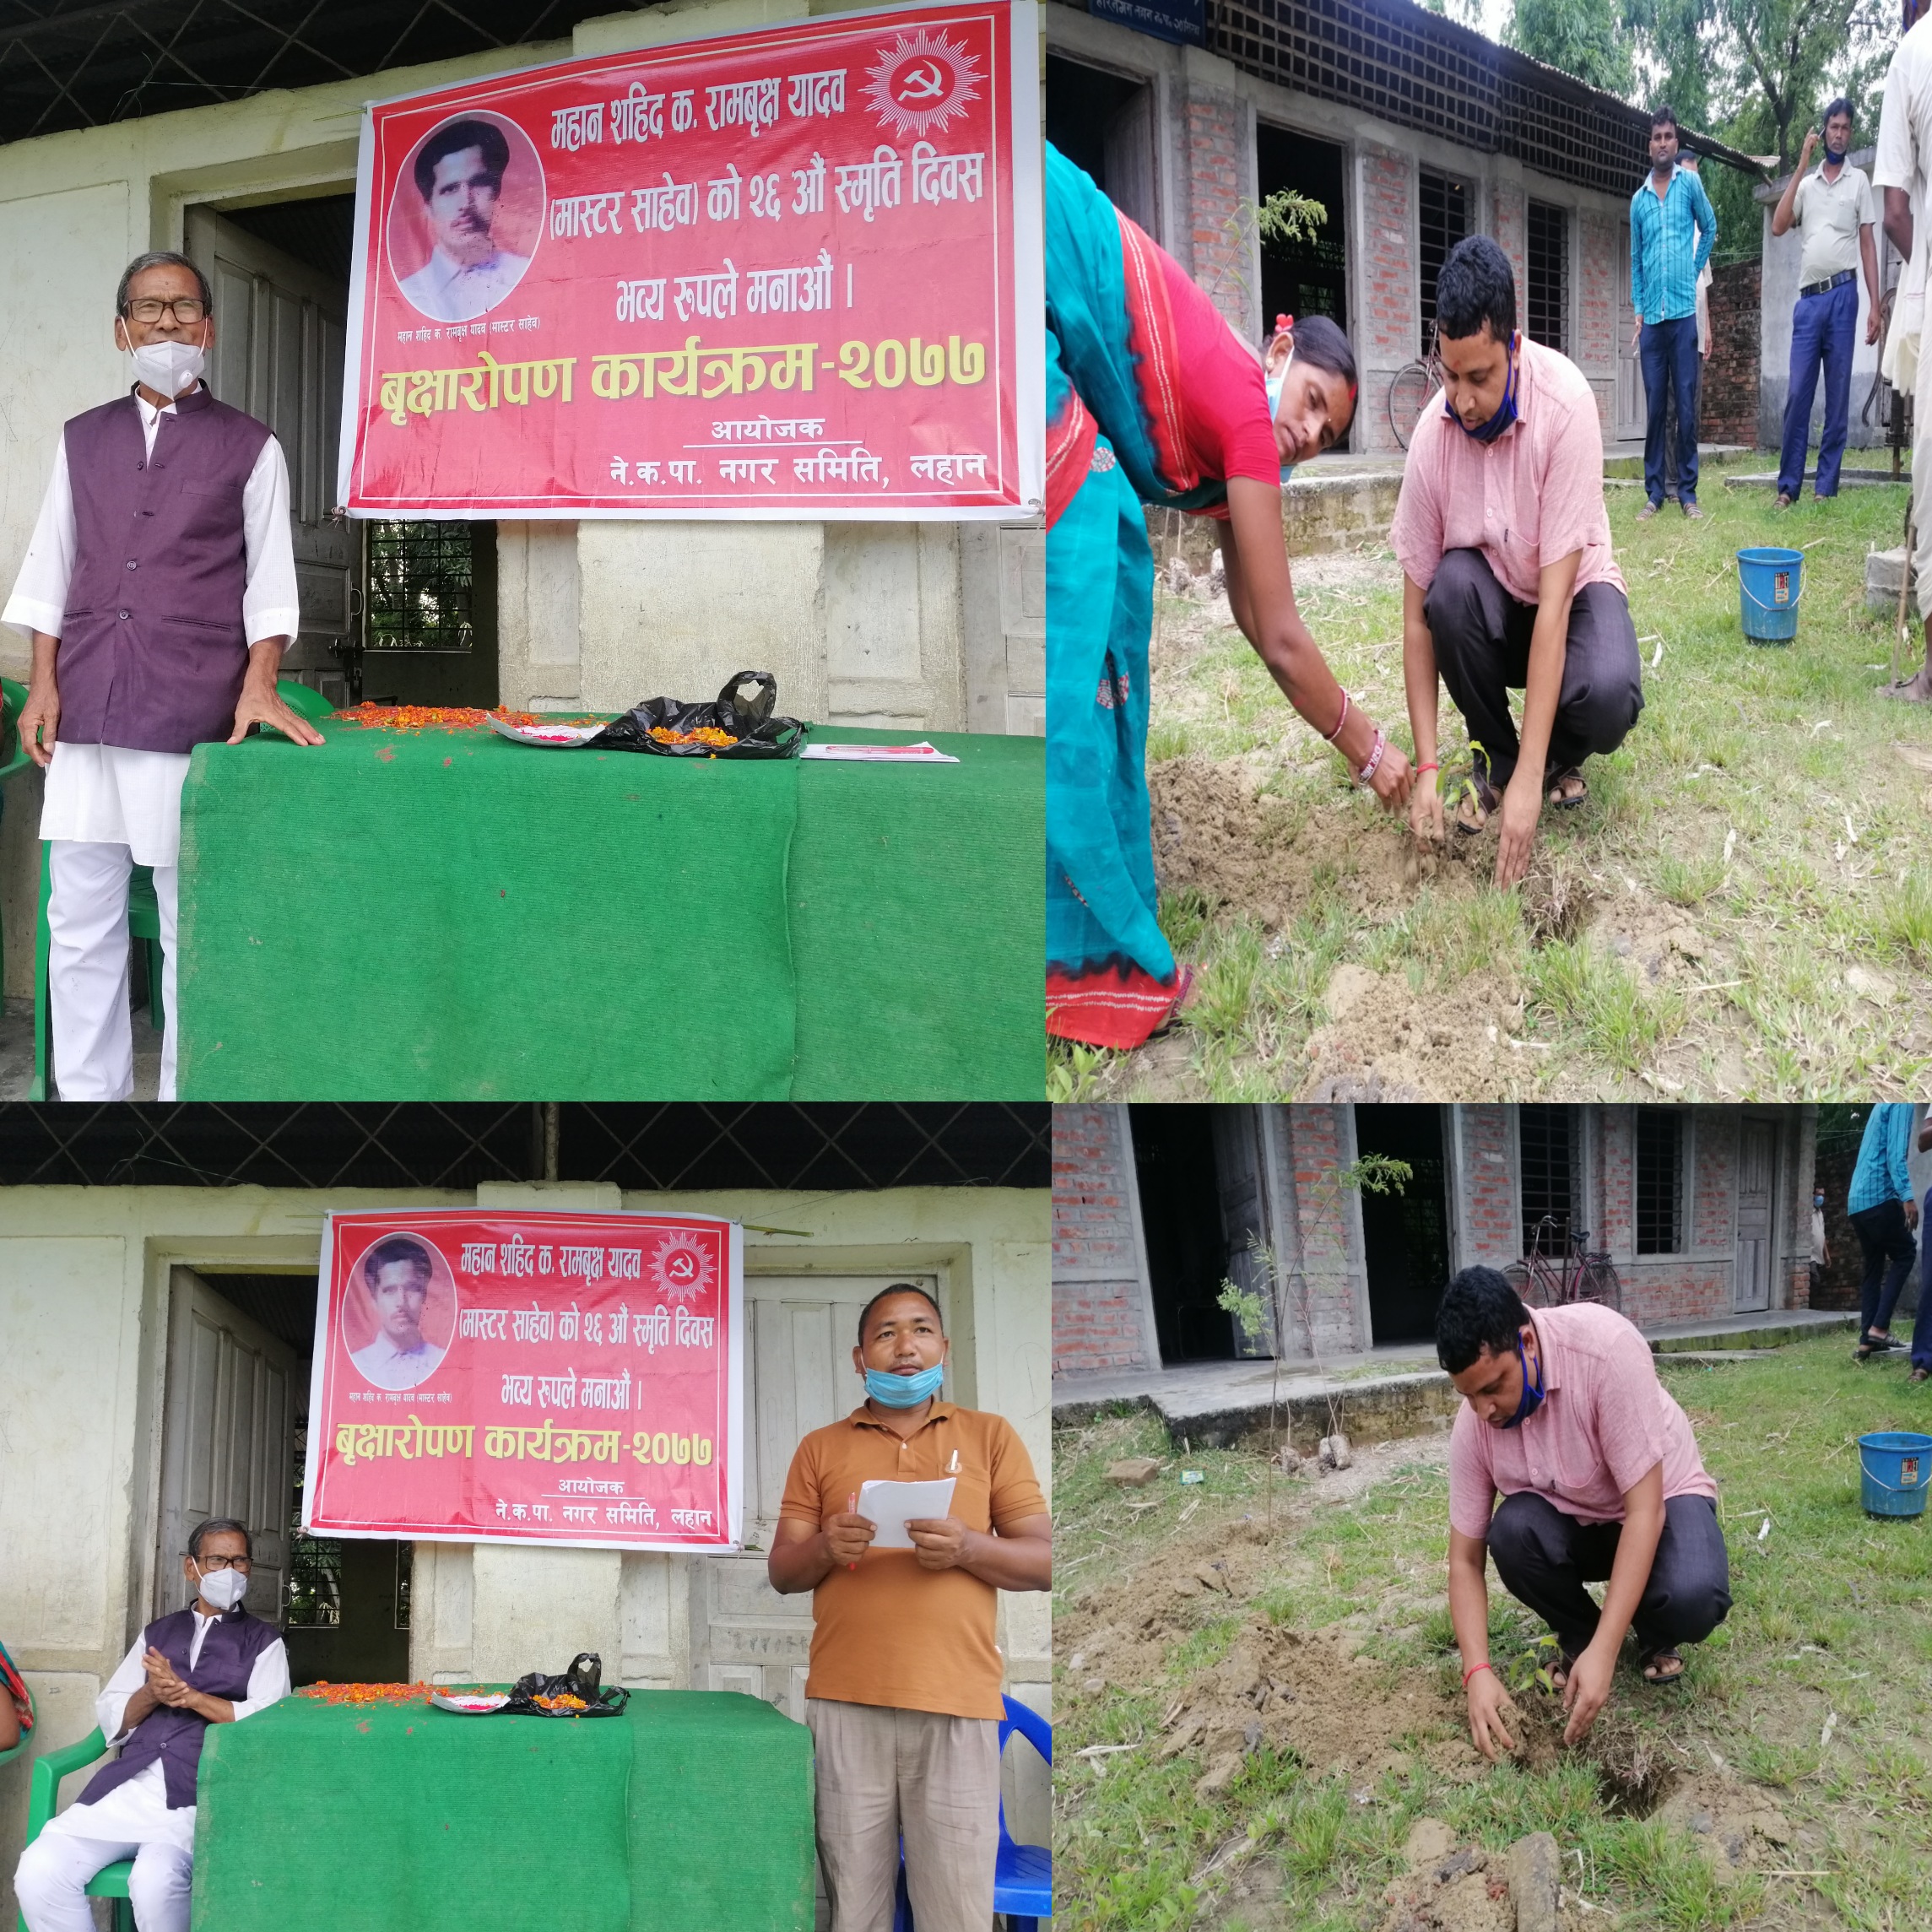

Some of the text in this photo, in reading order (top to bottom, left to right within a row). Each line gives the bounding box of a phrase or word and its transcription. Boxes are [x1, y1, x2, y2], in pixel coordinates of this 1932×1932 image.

[551, 68, 847, 151] महान शहिद क. रामबृक्ष यादव
[550, 192, 625, 240] (मास्टर
[707, 163, 742, 221] को
[750, 174, 781, 222] २६
[835, 145, 903, 222] स्मृति
[912, 141, 984, 206] दिवस
[616, 279, 666, 322] भव्य
[381, 351, 576, 424] बृक्षारोपण
[712, 415, 825, 441] आयोजक
[610, 447, 987, 489] ने.क.पा. नगर समिति, लहान
[461, 1233, 641, 1286] महान शहिद क. रामबृक्ष यादव
[459, 1309, 508, 1340] (मास्टर
[559, 1302, 580, 1341] को
[584, 1312, 602, 1346] २६
[633, 1305, 670, 1354] स्मृति
[675, 1305, 714, 1349] दिवस
[501, 1374, 533, 1405] भव्य
[336, 1415, 475, 1464] बृक्षारोपण
[558, 1477, 625, 1495] आयोजक
[496, 1499, 712, 1529] ने.क.पा. नगर समिति, लहान
